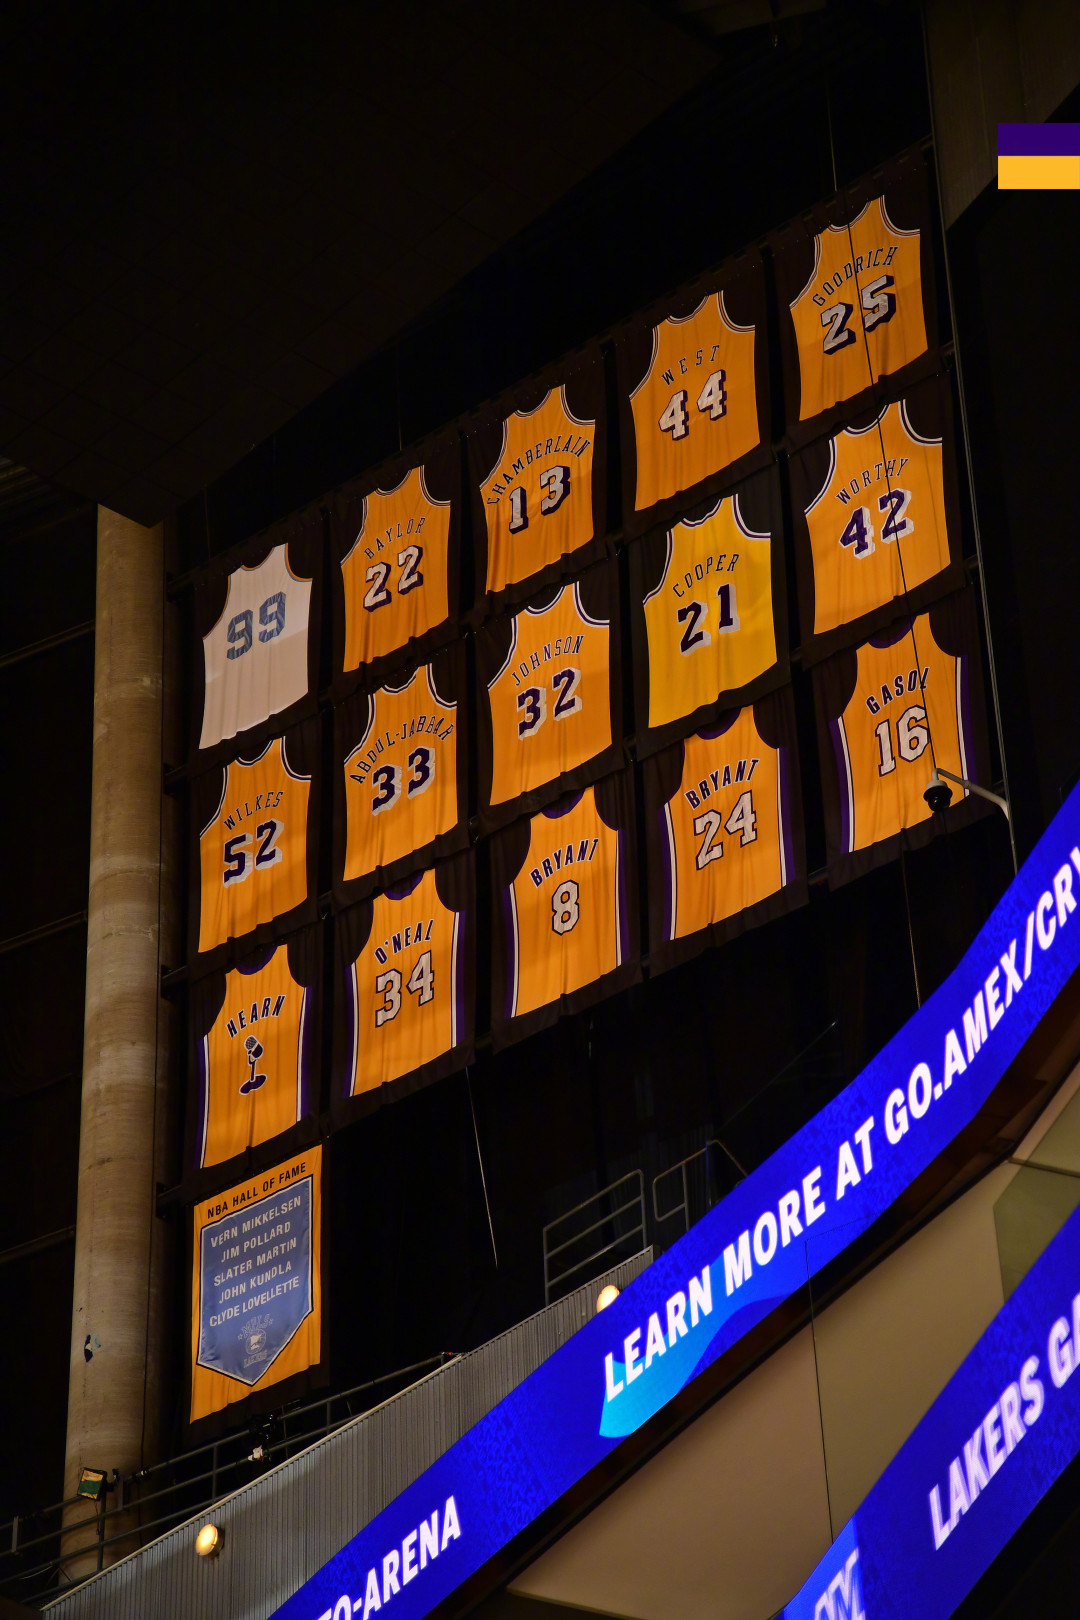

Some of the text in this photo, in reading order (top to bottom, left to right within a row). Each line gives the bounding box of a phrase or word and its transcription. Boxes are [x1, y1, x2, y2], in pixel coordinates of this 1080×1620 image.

[812, 246, 898, 307] GOODRICH
[820, 274, 897, 355] 25
[660, 344, 720, 386] WEST
[658, 369, 727, 441] 44
[486, 434, 591, 506] CHAMBERLAIN
[836, 457, 909, 505] WORTHY
[508, 465, 571, 535] 13
[838, 487, 914, 560] 42
[364, 516, 426, 559] BAYLOR
[363, 545, 424, 613] 22
[672, 553, 740, 598] COOPER
[226, 591, 286, 661] 99
[676, 582, 740, 657] 21
[511, 634, 585, 686] JOHNSON
[516, 666, 583, 741] 32
[866, 667, 930, 715] GASOL
[349, 715, 454, 784] ABDUL-JABBAR
[875, 704, 929, 777] 16
[223, 790, 284, 831] WILKES
[372, 745, 436, 817] 33
[684, 758, 760, 810] BRYANT
[222, 817, 284, 888] 52
[693, 790, 758, 871] 24
[529, 837, 599, 888] BRYANT
[551, 879, 580, 935] 8
[374, 918, 435, 965] O'NEAL
[226, 994, 286, 1038] HEARN
[375, 950, 435, 1028] 34
[207, 1162, 306, 1219] NBA HALL OF FAME
[210, 1196, 301, 1248] VERN MIKKELSEN
[221, 1221, 291, 1263] JIM POLLARD
[213, 1237, 297, 1287] SLATER MARTIN
[219, 1261, 292, 1304] JOHN KUNDLA
[604, 1265, 713, 1403] LEARN
[722, 1165, 826, 1297] MORE
[836, 1115, 875, 1200] AT
[209, 1304, 240, 1327] CLYDE
[242, 1276, 299, 1312] LOVELLETTE
[928, 1290, 1080, 1551] LAKERS G
